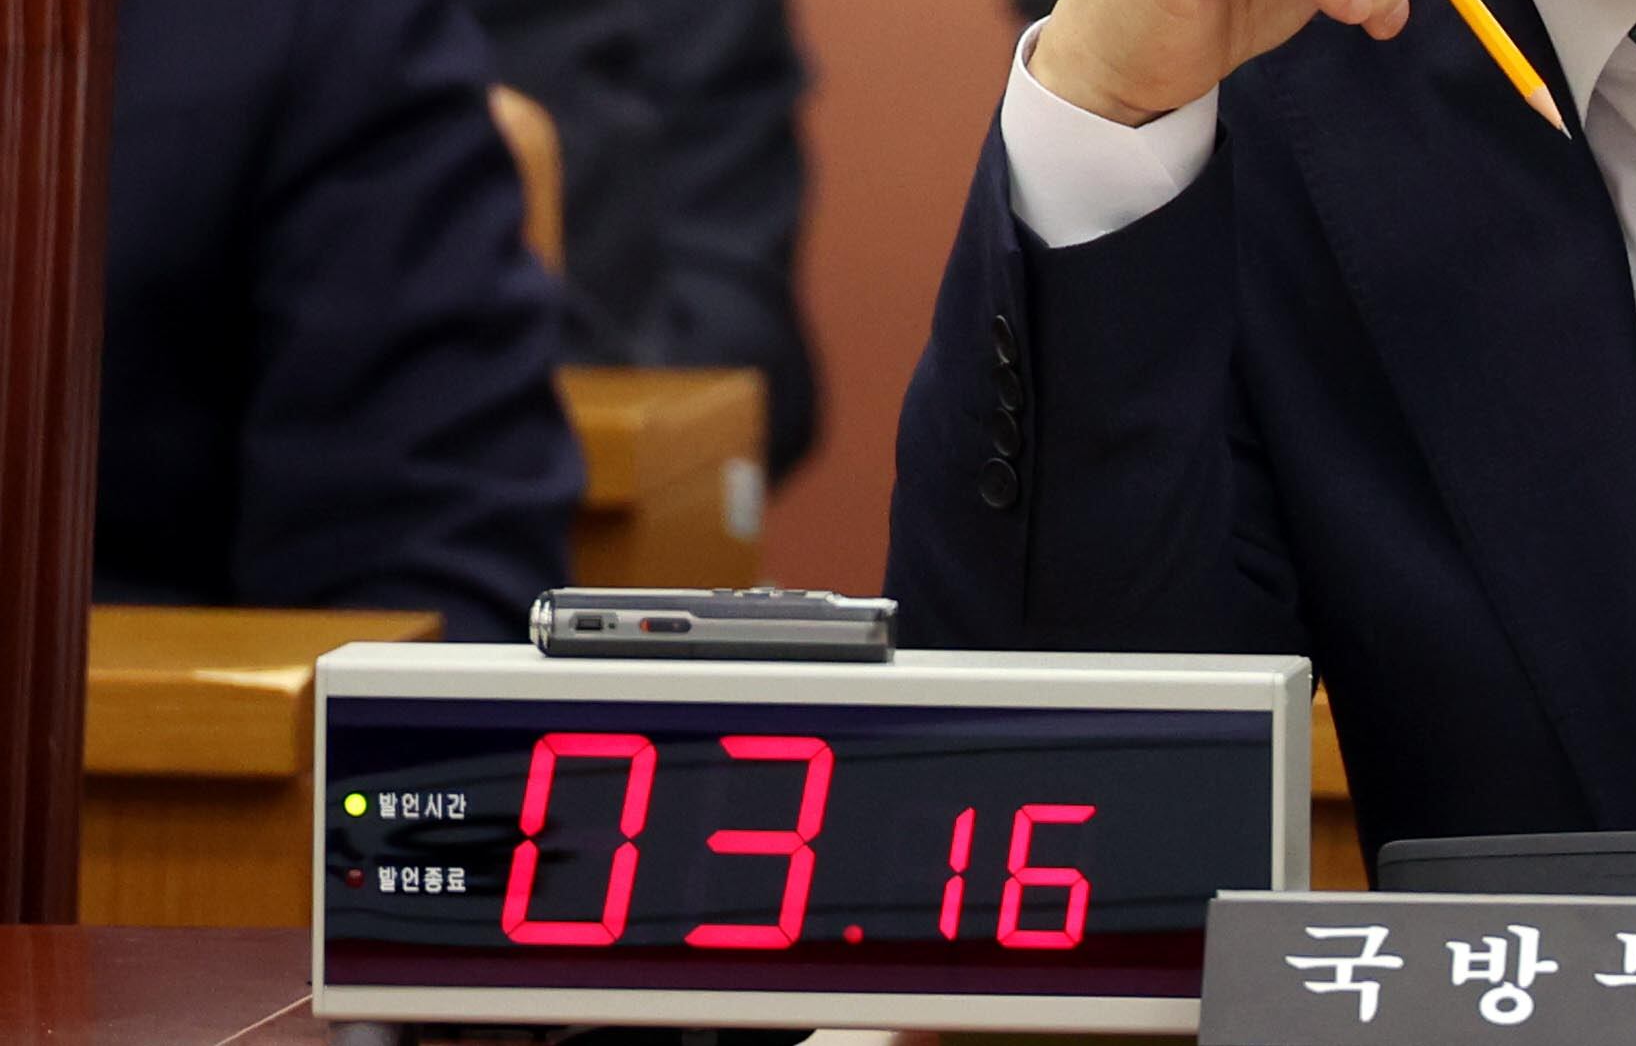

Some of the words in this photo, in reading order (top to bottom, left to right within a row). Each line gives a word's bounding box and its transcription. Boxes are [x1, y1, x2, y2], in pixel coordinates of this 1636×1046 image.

[378, 791, 467, 820] 발언시간
[502, 733, 1095, 950] 03.16
[377, 865, 467, 894] 발언종료
